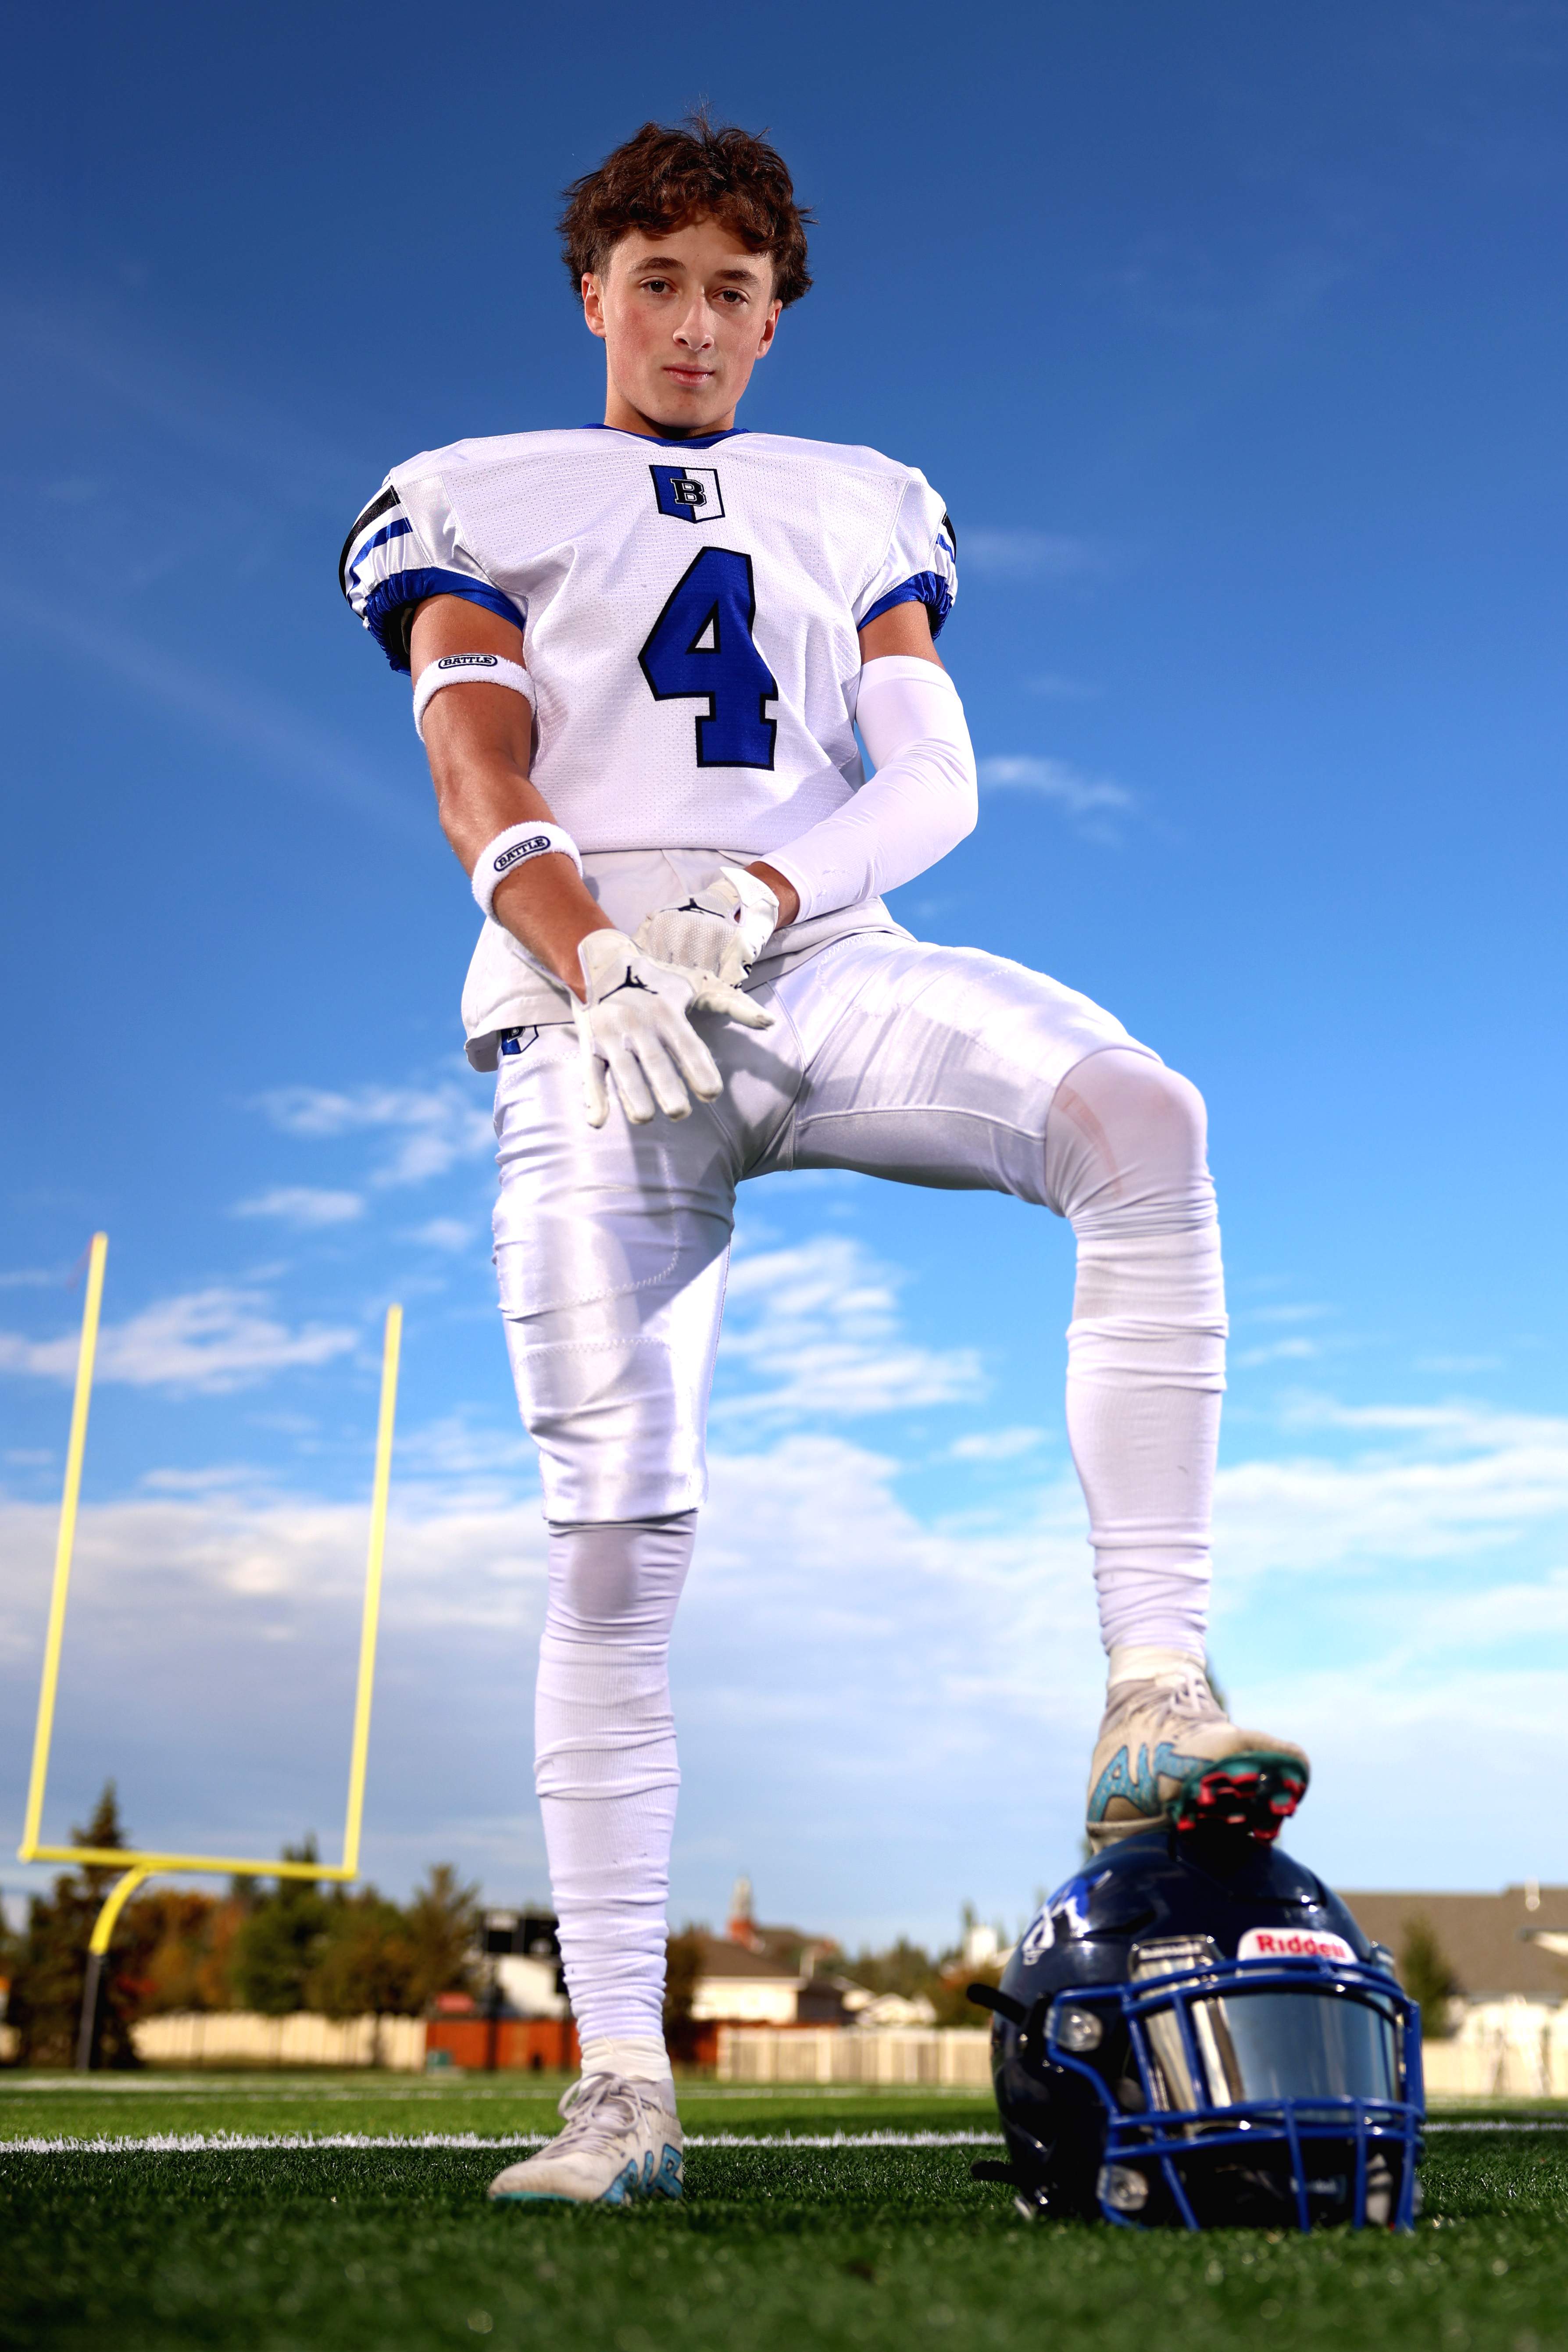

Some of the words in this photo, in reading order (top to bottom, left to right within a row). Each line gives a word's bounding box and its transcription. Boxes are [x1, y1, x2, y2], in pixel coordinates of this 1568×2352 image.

[670, 478, 706, 507] B
[443, 657, 493, 666] BATTLE
[638, 546, 779, 771] 4
[497, 839, 545, 867] BATTLE
